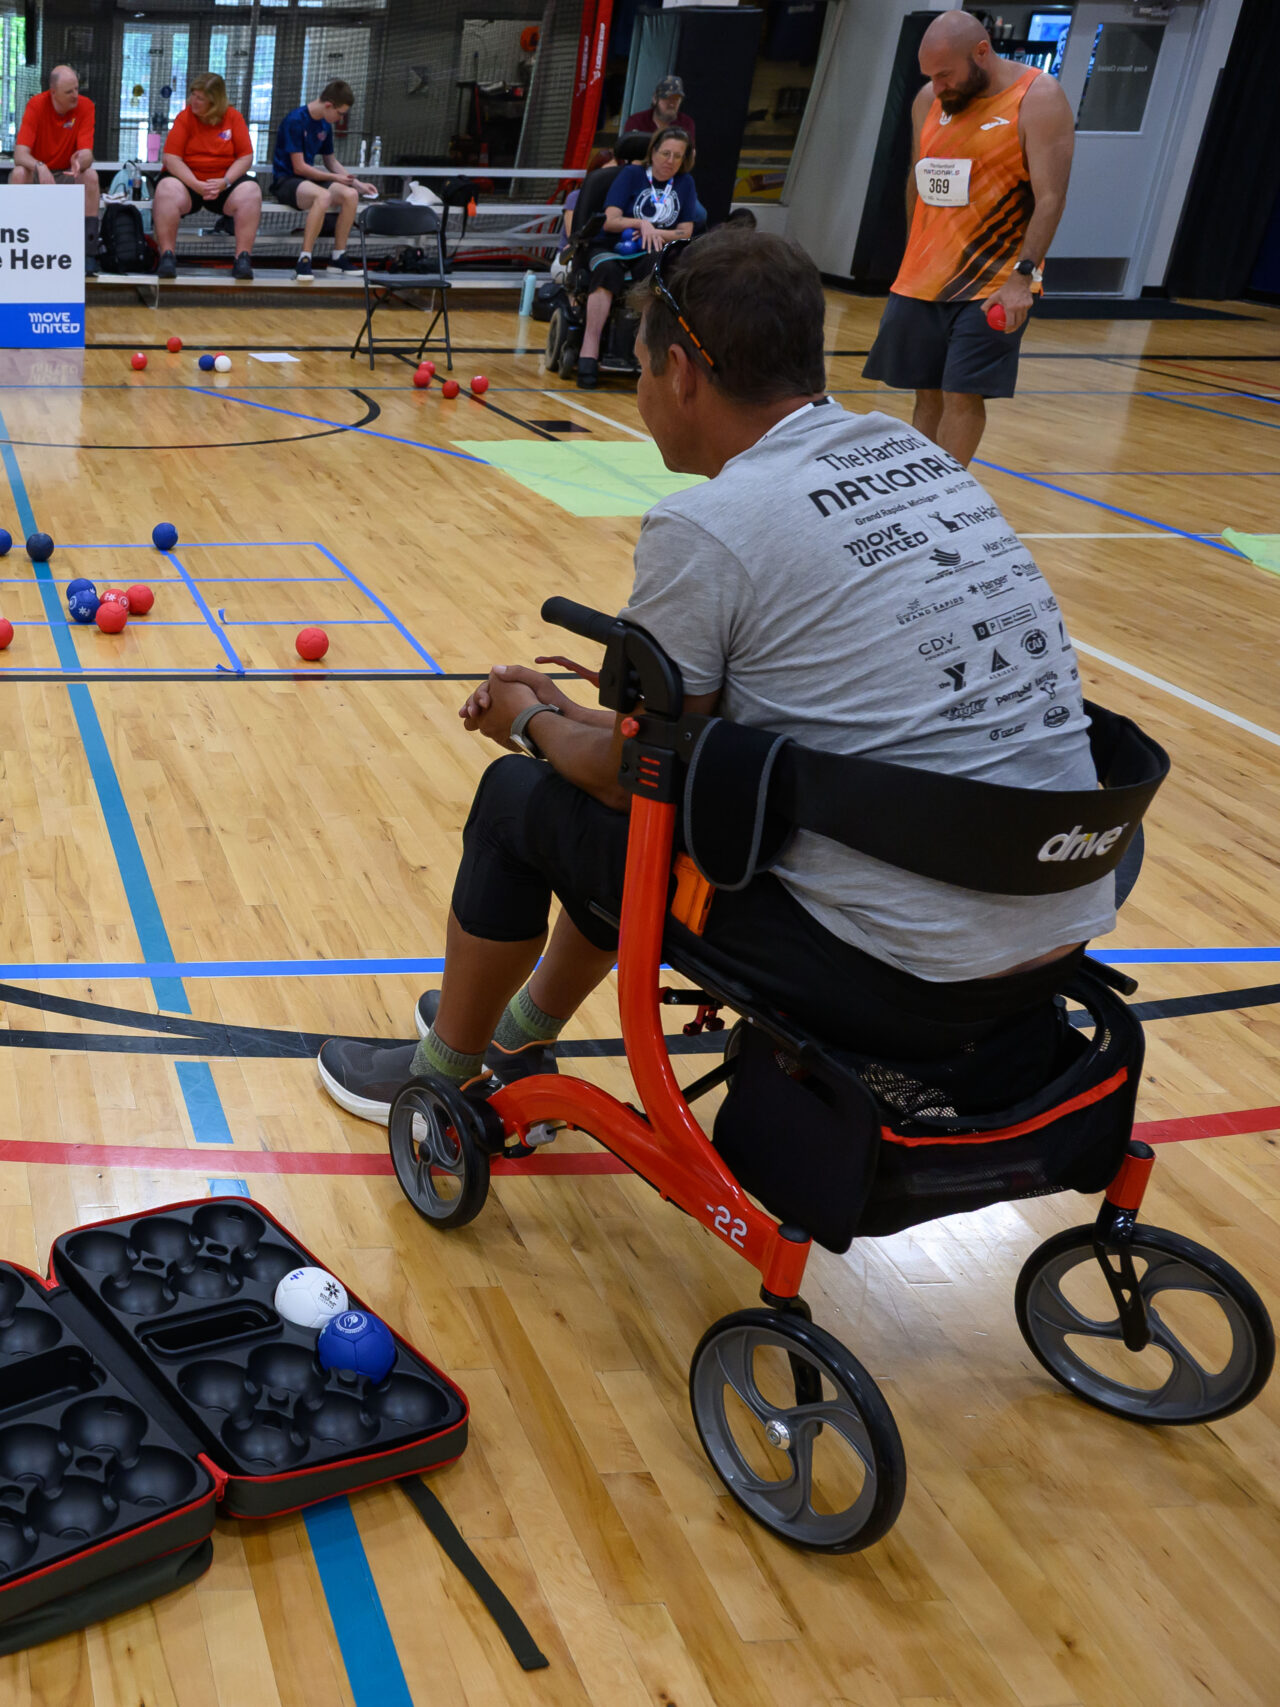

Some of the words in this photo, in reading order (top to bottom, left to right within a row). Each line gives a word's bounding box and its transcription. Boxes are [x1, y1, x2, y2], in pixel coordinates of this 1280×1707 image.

[928, 178, 950, 194] 369
[10, 249, 72, 270] Here
[28, 312, 71, 324] MOVE
[31, 322, 80, 334] UNITED
[807, 453, 967, 518] NATIONALS
[854, 510, 882, 526] Grand
[907, 493, 940, 508] Michigan
[842, 522, 908, 556] MOVE
[858, 531, 929, 567] UNITED
[977, 574, 1008, 591] Hanger
[932, 596, 965, 612] RAPIDS
[1037, 825, 1123, 862] drive
